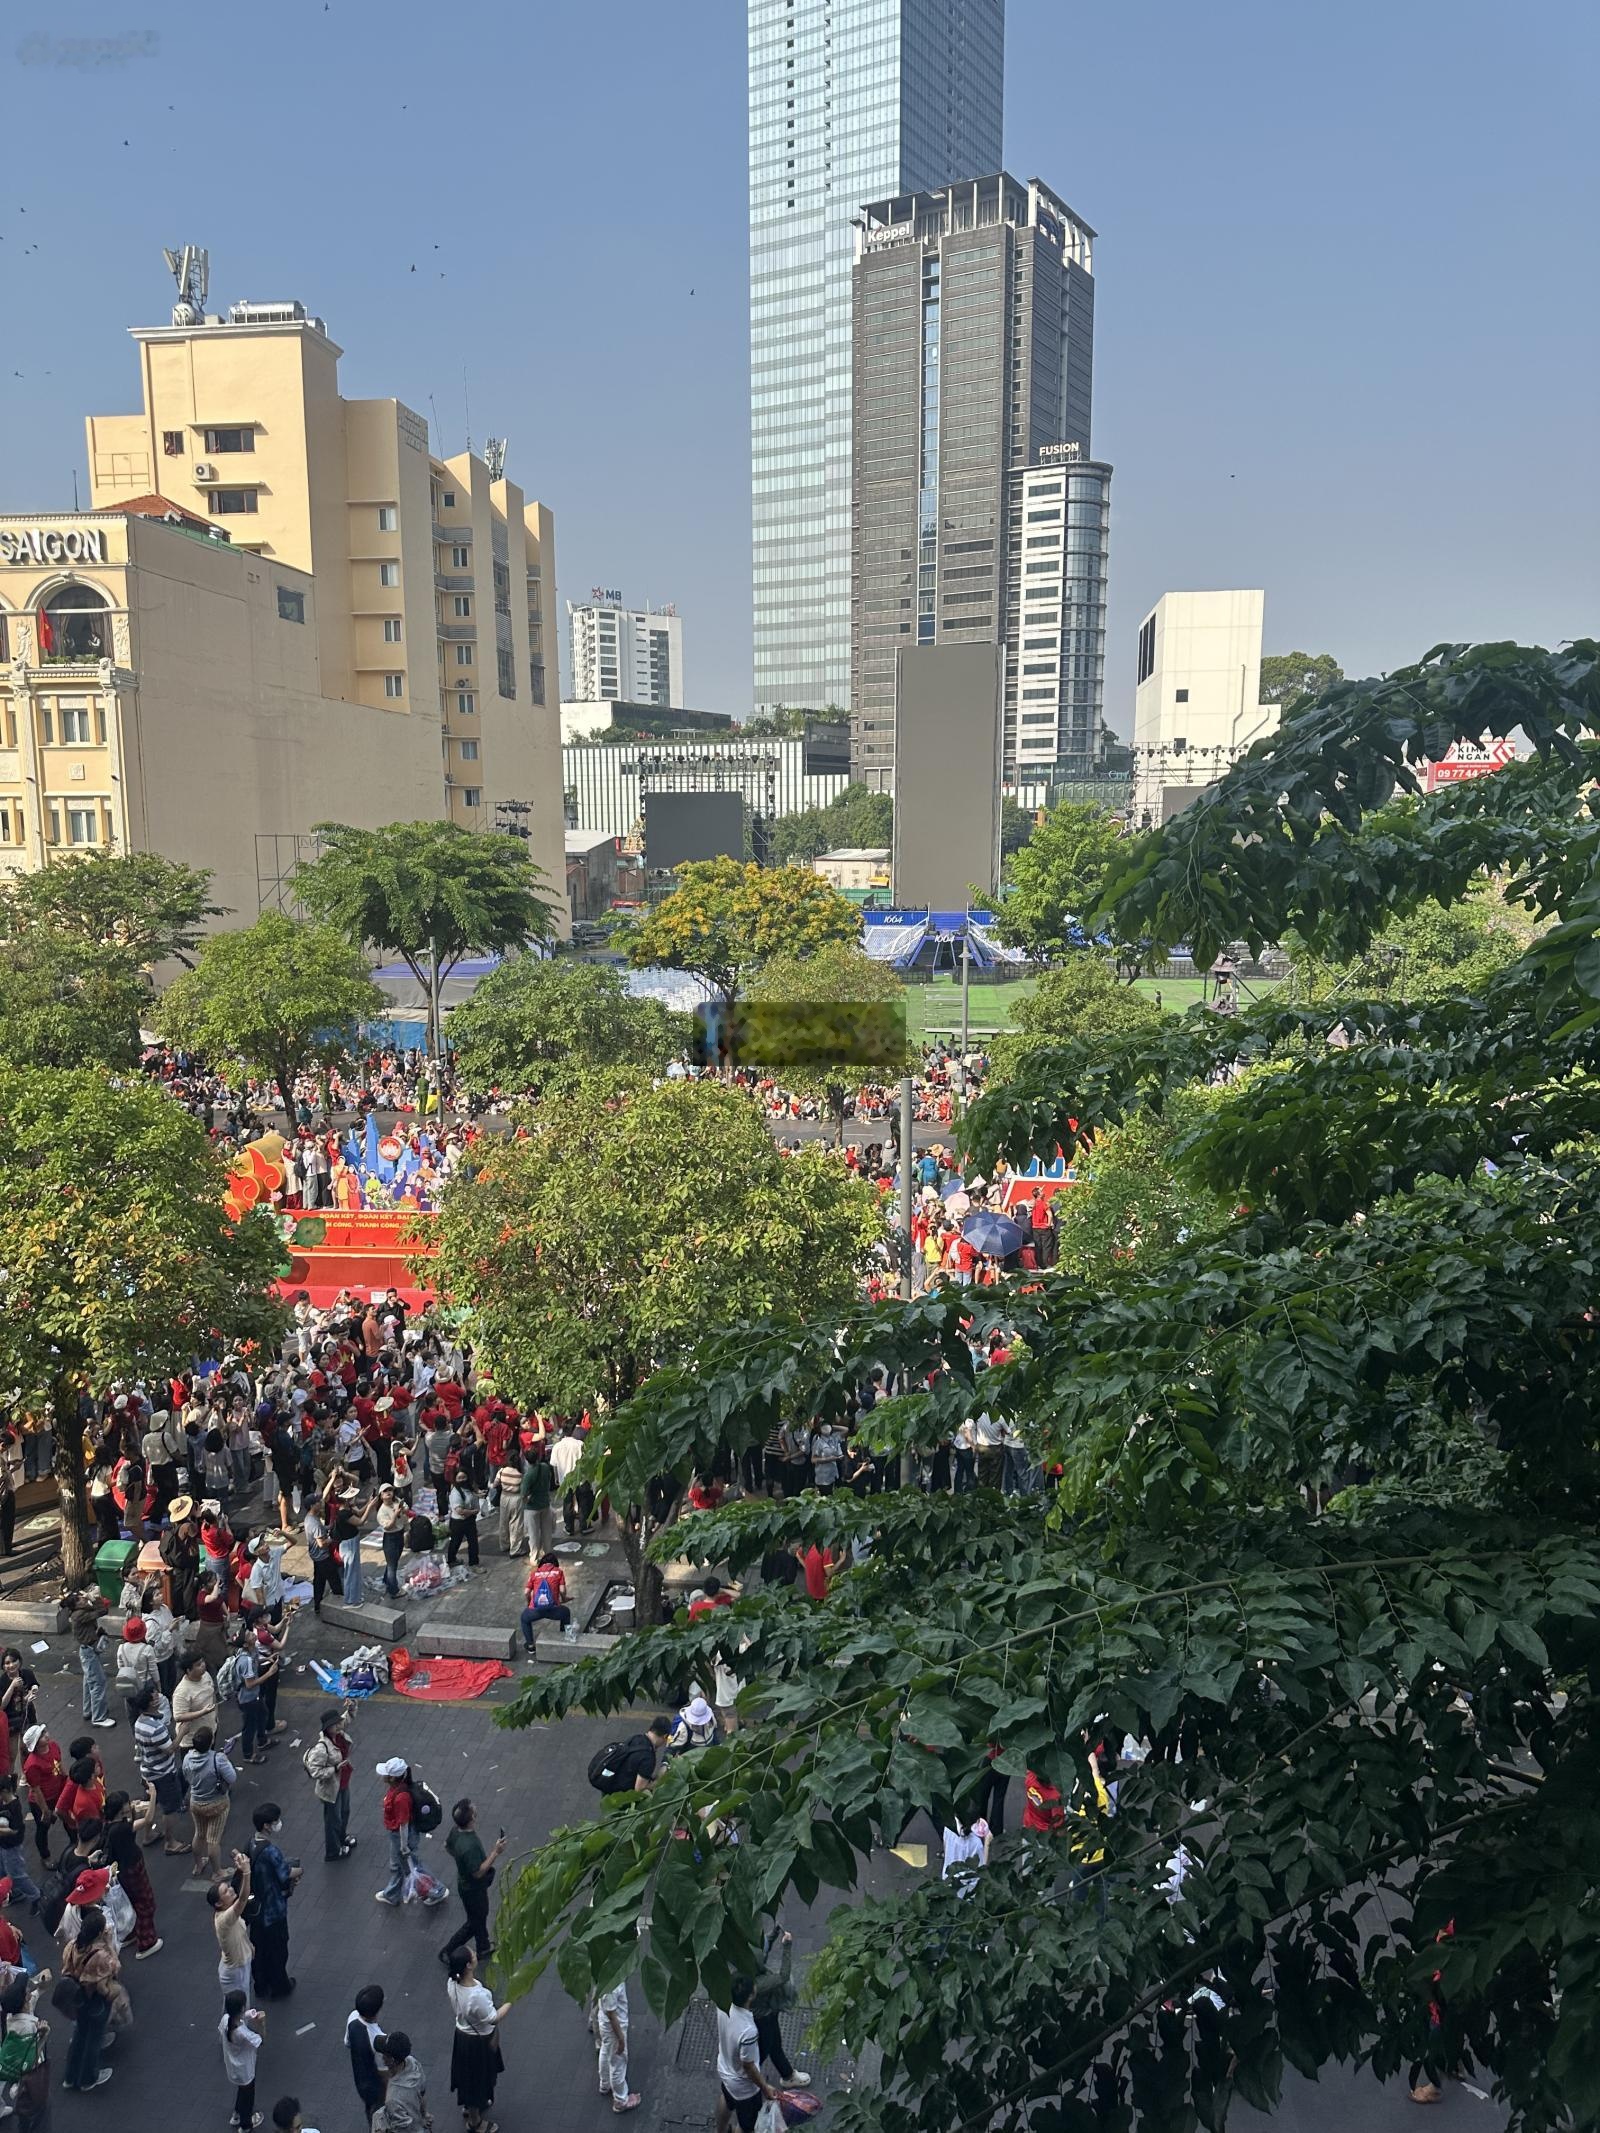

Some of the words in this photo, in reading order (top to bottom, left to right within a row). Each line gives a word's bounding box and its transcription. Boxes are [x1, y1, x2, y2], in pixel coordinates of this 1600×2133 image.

[867, 222, 910, 243] Keppel
[1039, 442, 1079, 457] FUSION
[0, 528, 102, 562] SAIGON
[606, 590, 622, 601] MB
